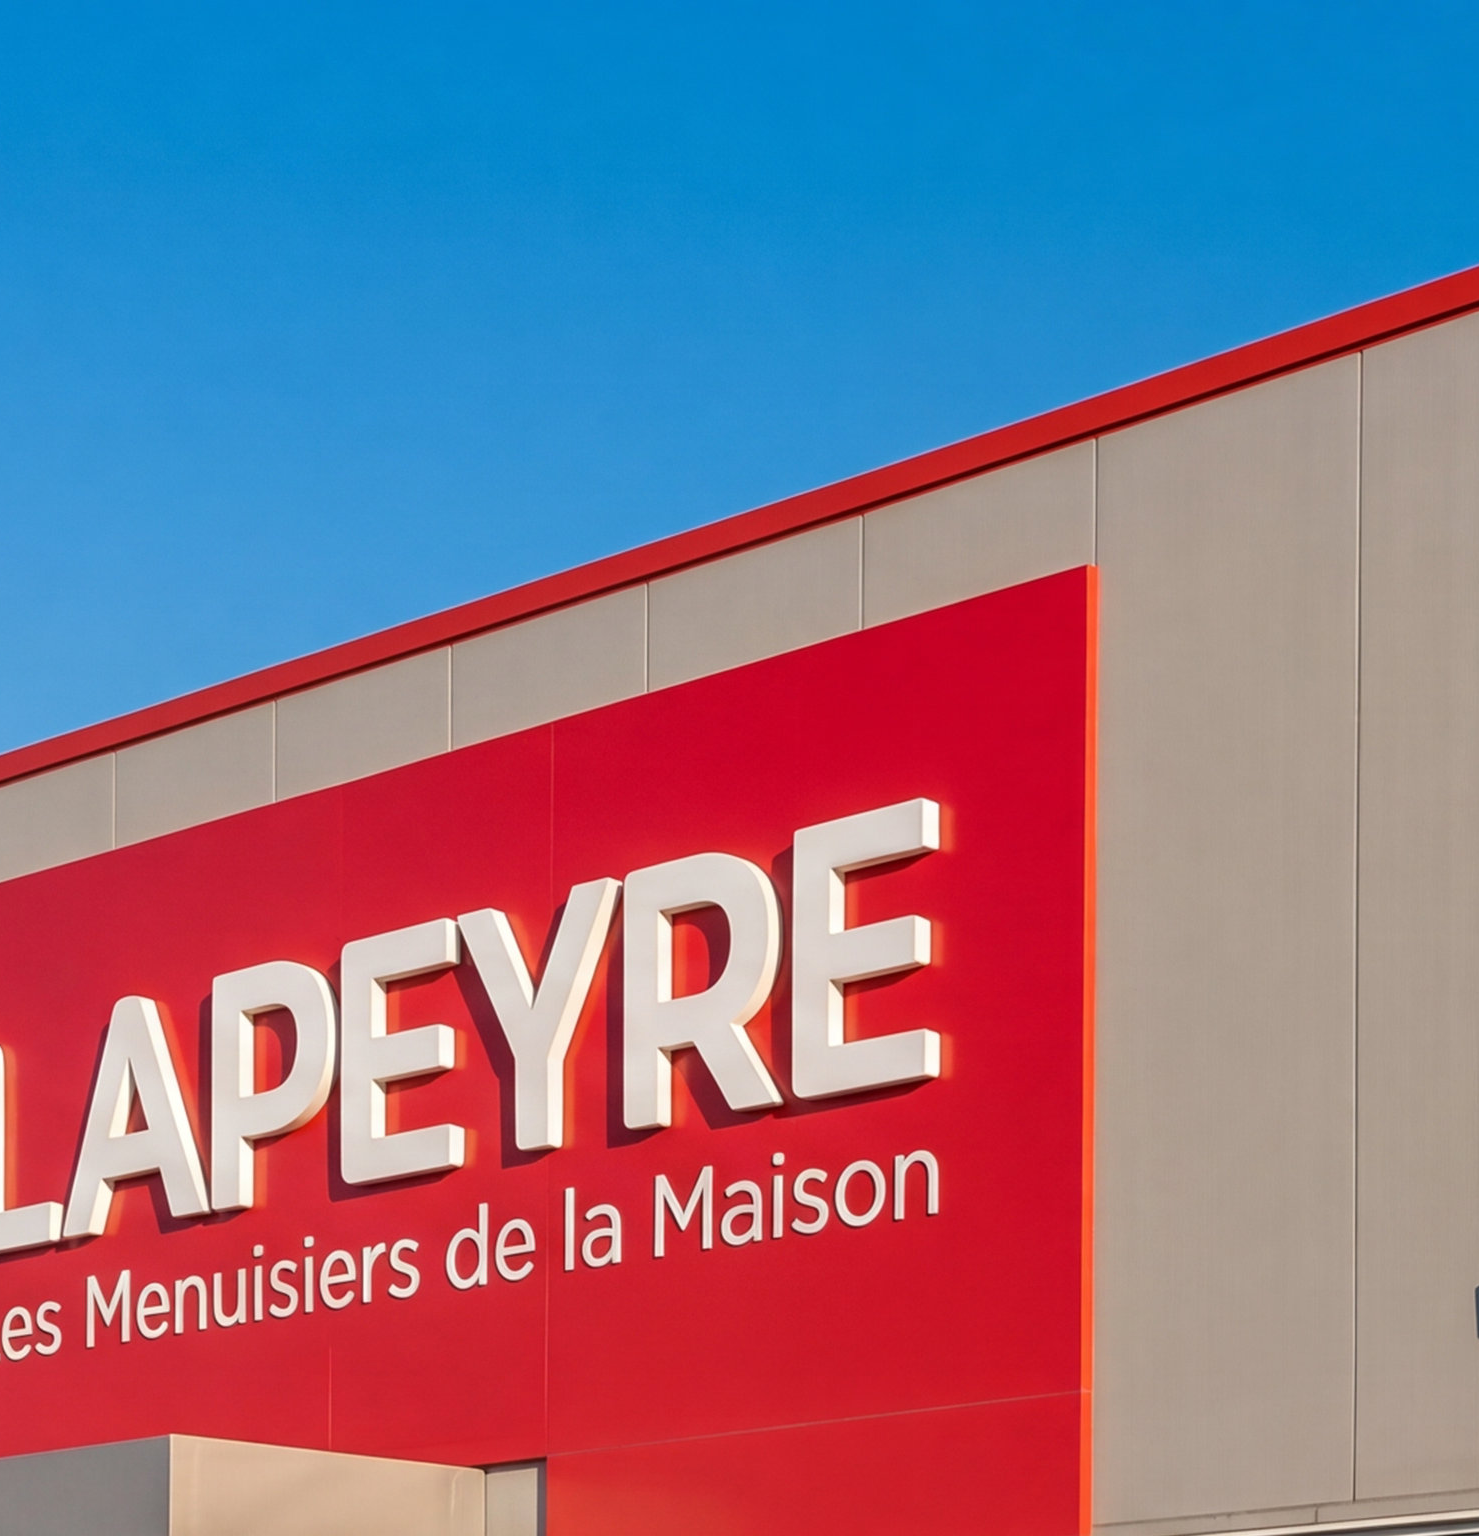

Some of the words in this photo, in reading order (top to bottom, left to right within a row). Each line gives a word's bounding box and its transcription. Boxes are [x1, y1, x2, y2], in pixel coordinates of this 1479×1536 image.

[85, 1235, 422, 1349] Menuisiers
[444, 1202, 537, 1290] de
[563, 1186, 622, 1271] la
[653, 1149, 940, 1258] Maison
